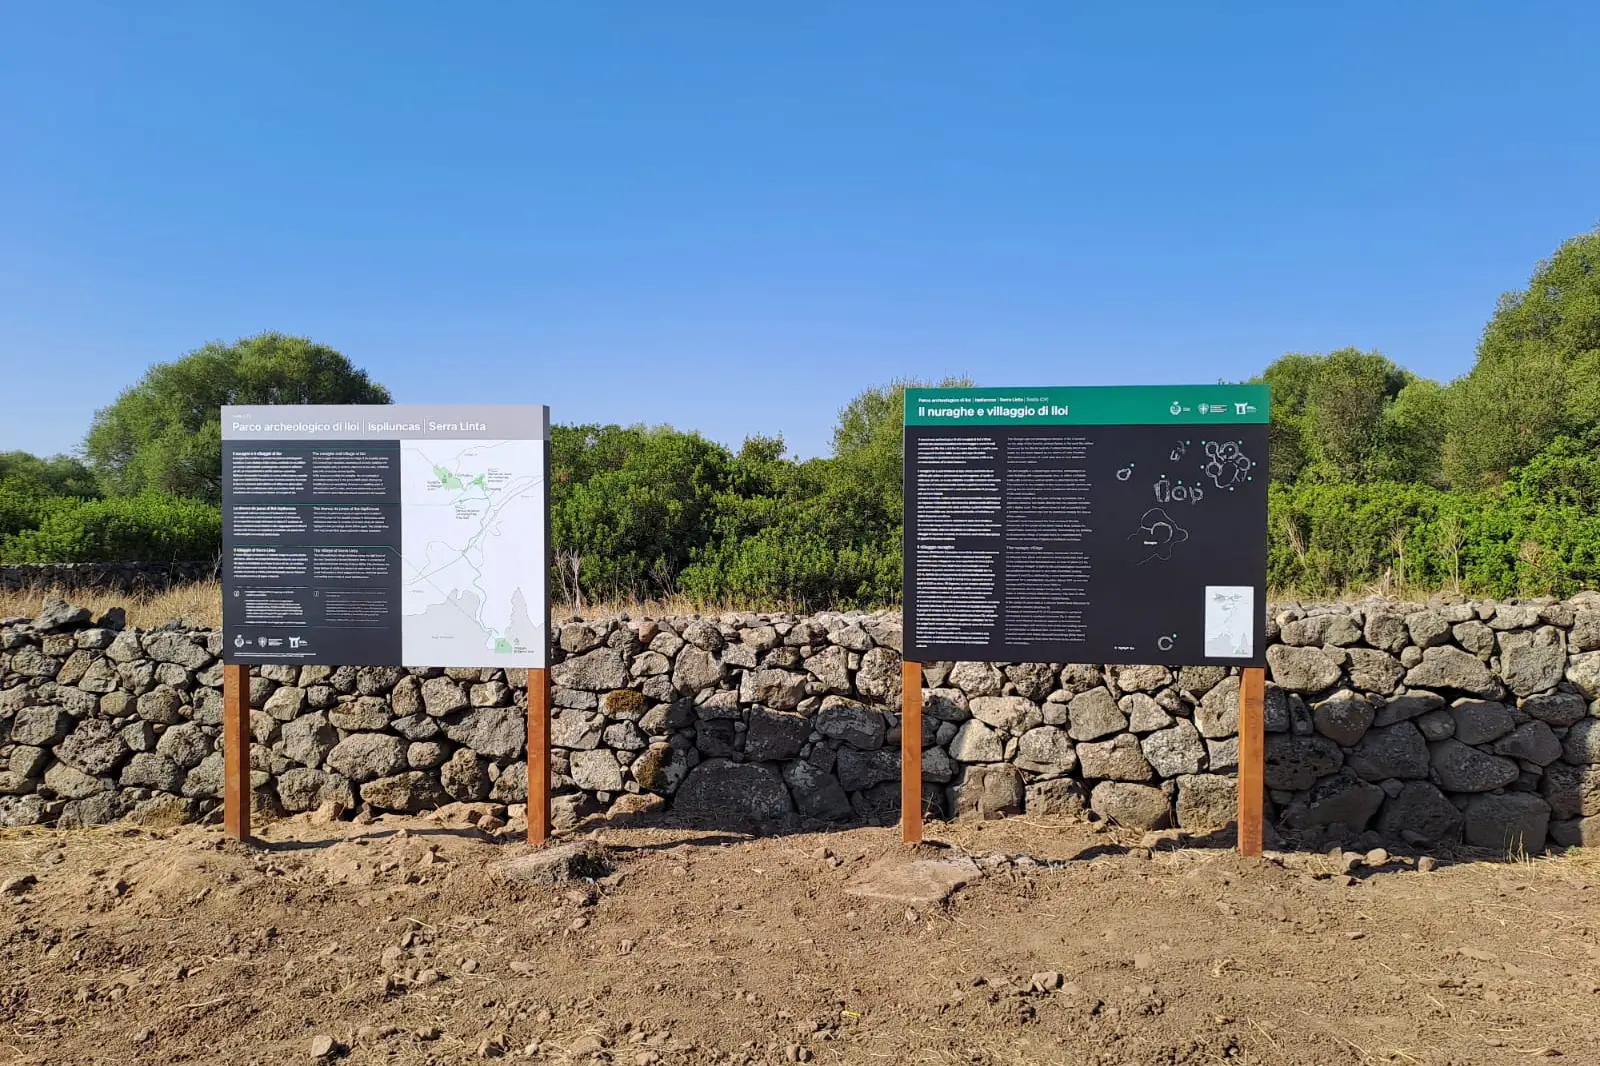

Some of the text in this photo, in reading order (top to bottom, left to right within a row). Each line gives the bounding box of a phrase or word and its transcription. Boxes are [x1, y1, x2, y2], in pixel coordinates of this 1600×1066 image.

[918, 406, 925, 417] Il
[927, 406, 975, 419] nuraghe
[976, 408, 985, 417] e
[987, 405, 1035, 418] villaggio
[1037, 405, 1049, 416] di
[232, 421, 262, 432] Parco
[264, 421, 330, 434] archeologico
[332, 421, 342, 432] di
[428, 421, 458, 431] Serra
[460, 421, 486, 431] Linta
